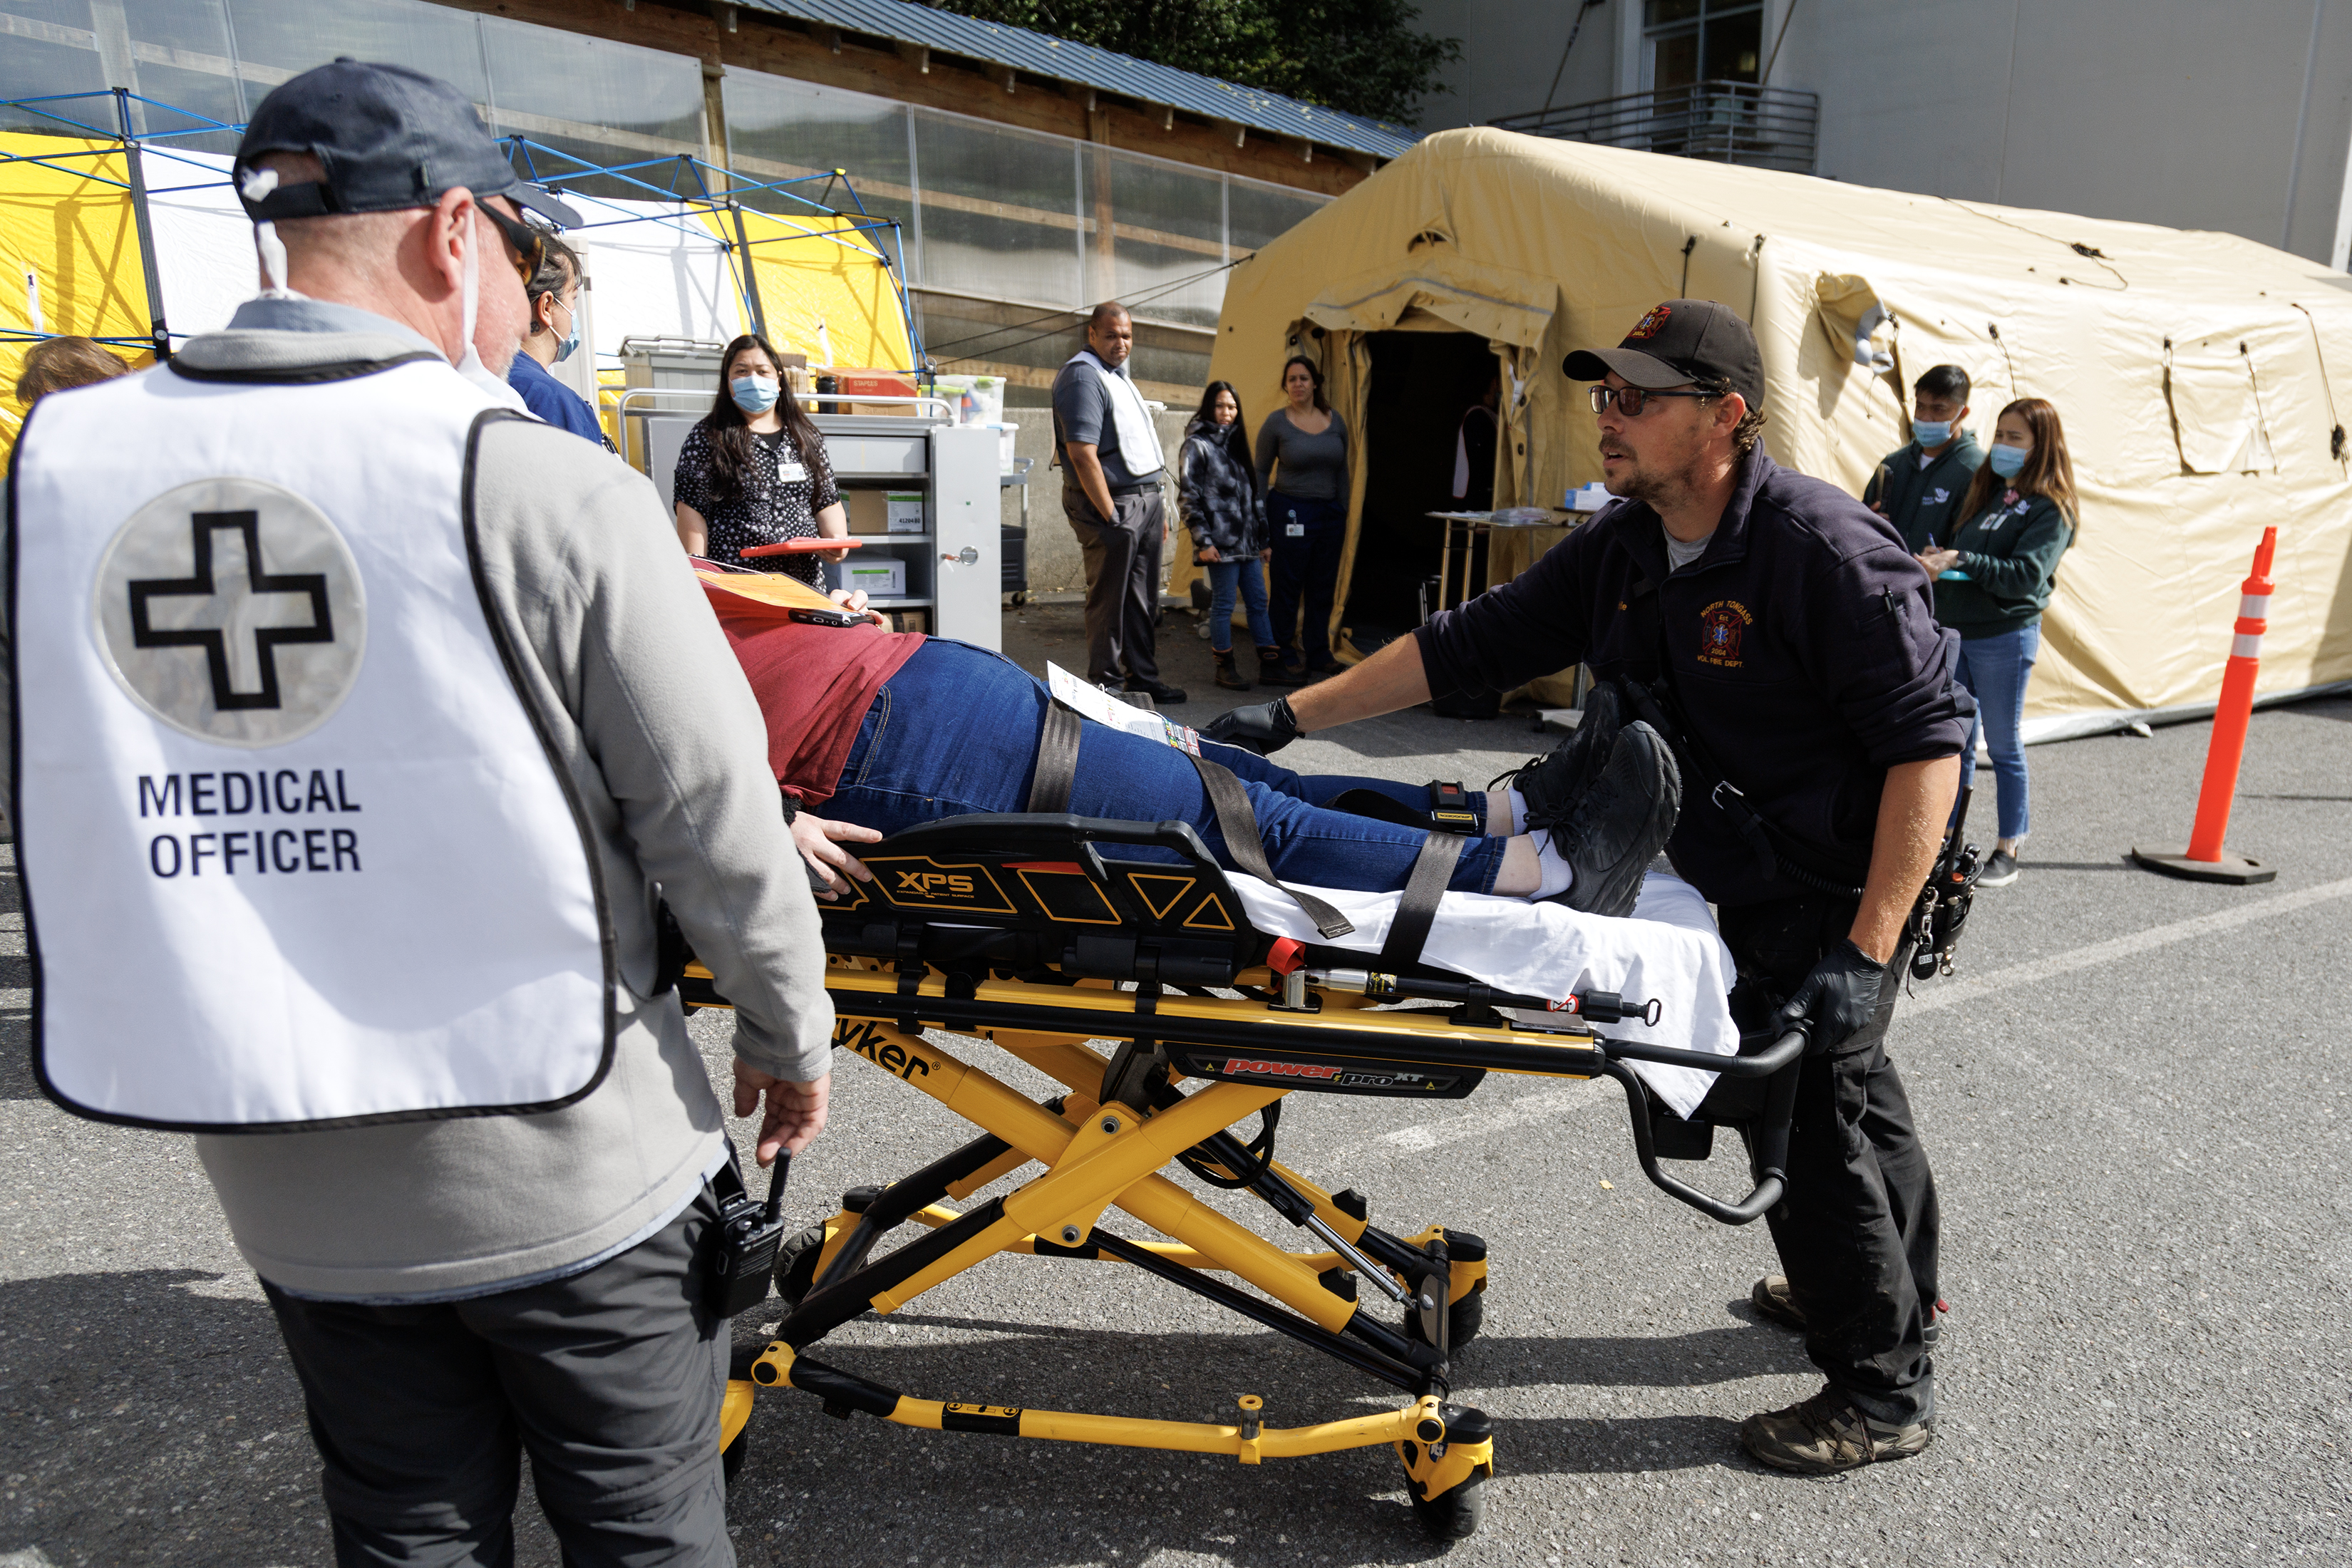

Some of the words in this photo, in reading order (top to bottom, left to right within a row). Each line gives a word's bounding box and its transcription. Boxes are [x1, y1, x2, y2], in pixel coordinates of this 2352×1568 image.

[1701, 600, 1725, 618] NORTH
[1726, 600, 1753, 625] TONGASS
[1711, 647, 1726, 656] 2004
[138, 769, 362, 817] MEDICAL
[150, 829, 362, 878] OFFICER
[895, 870, 974, 896] XPS
[1222, 1058, 1343, 1078] power
[1341, 1073, 1393, 1085] pro
[1393, 1072, 1425, 1082] XT
